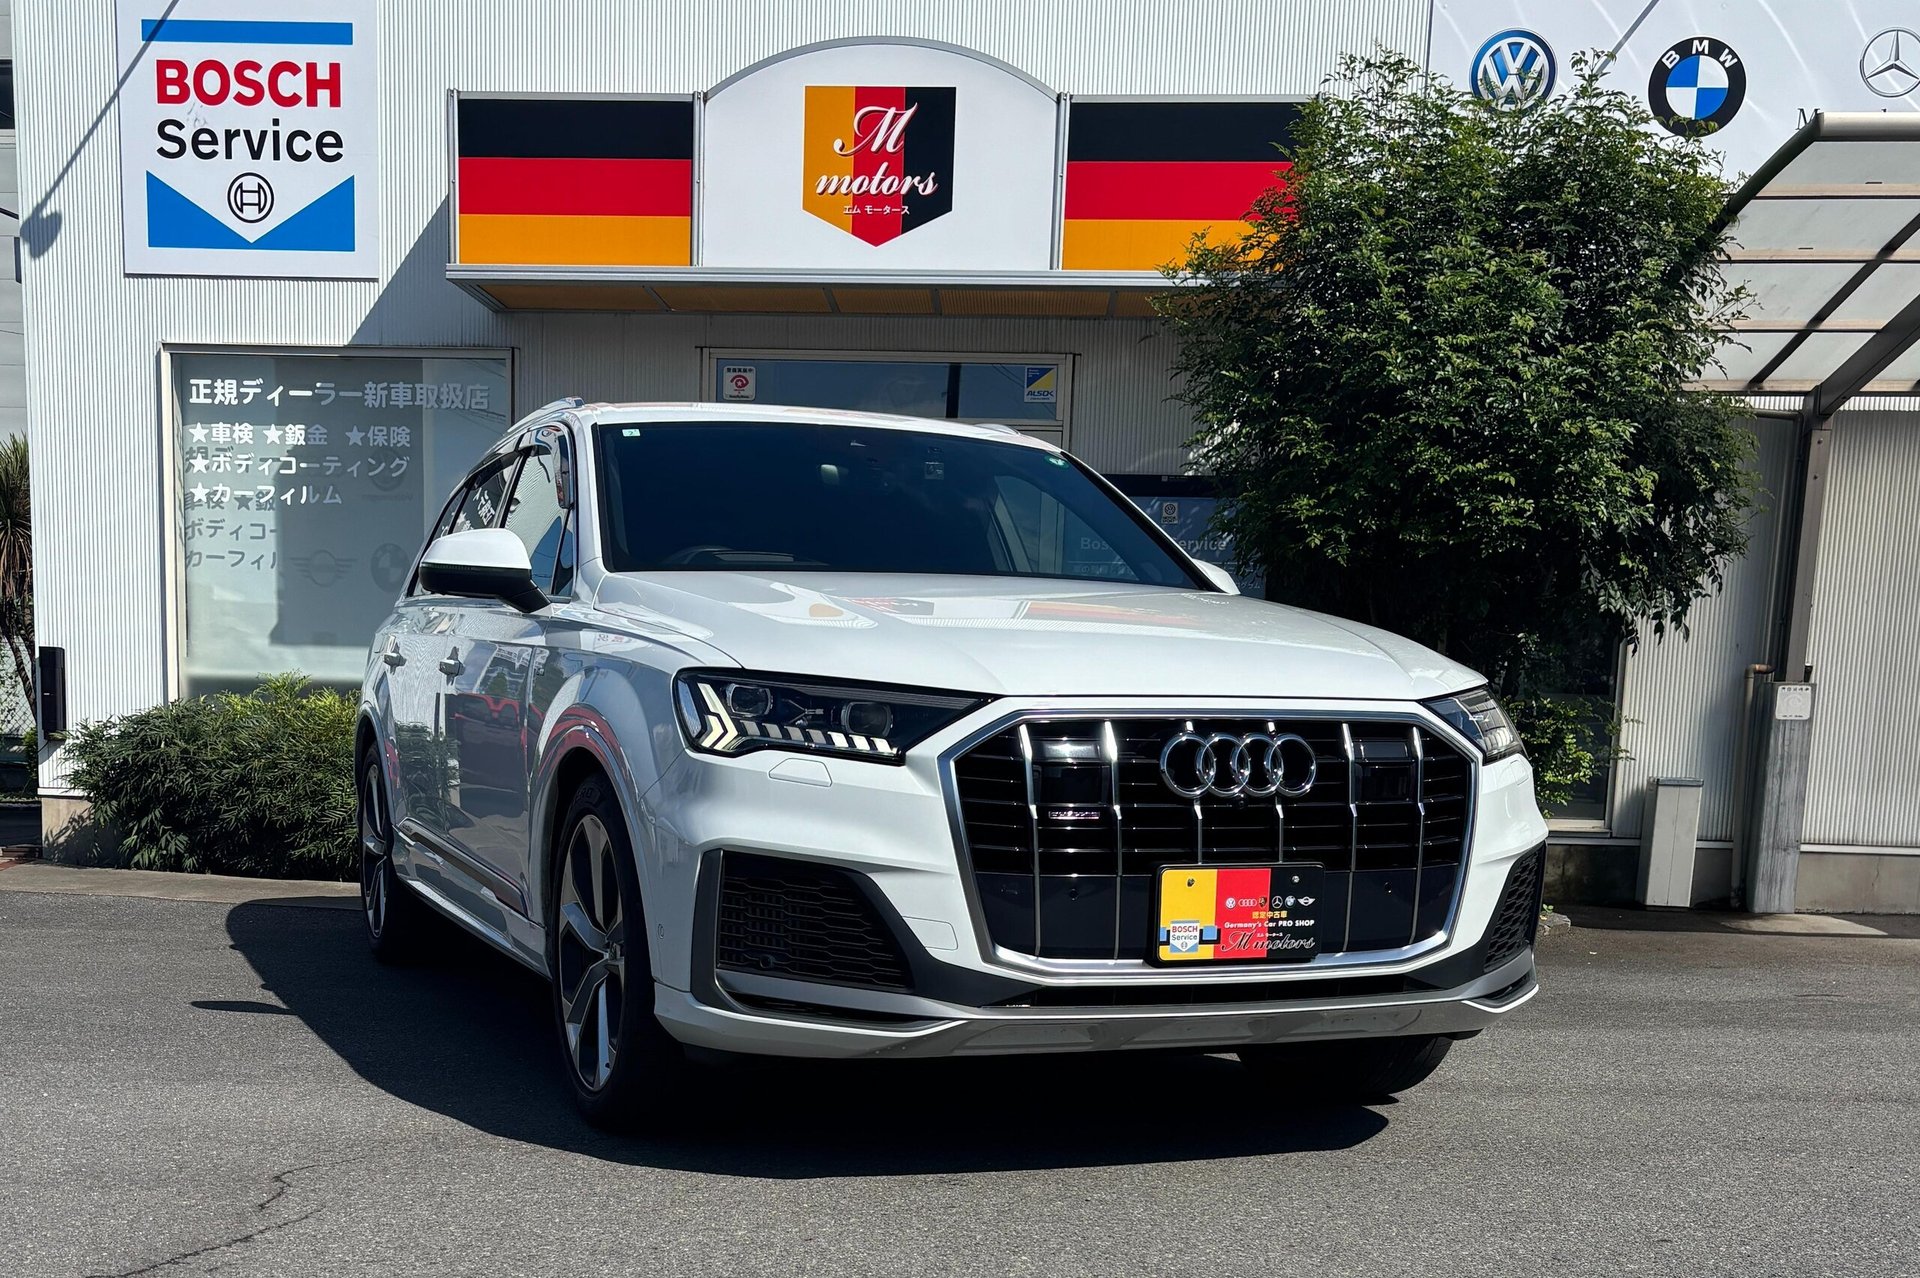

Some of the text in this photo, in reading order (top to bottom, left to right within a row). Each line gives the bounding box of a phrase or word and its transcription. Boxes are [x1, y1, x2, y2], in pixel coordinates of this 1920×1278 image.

[1661, 39, 1738, 70] BMW
[156, 59, 342, 108] BOSCH
[156, 117, 344, 163] Service
[833, 101, 918, 157] M
[815, 161, 939, 195] motors
[843, 204, 910, 215] エム モータース
[189, 377, 490, 411] 正規ディーラー新車取扱店
[211, 423, 254, 446] 車検
[367, 425, 411, 448] 保険
[211, 453, 410, 479] ボディコーティング
[211, 482, 342, 506] カーフィルム
[1175, 536, 1227, 551] ervice
[1171, 925, 1198, 933] BOSCH
[1224, 921, 1262, 929] Germany's
[1278, 919, 1293, 927] PRO
[1295, 919, 1315, 927] SHOP
[1171, 933, 1198, 941] Service
[1221, 929, 1316, 952] M motors
